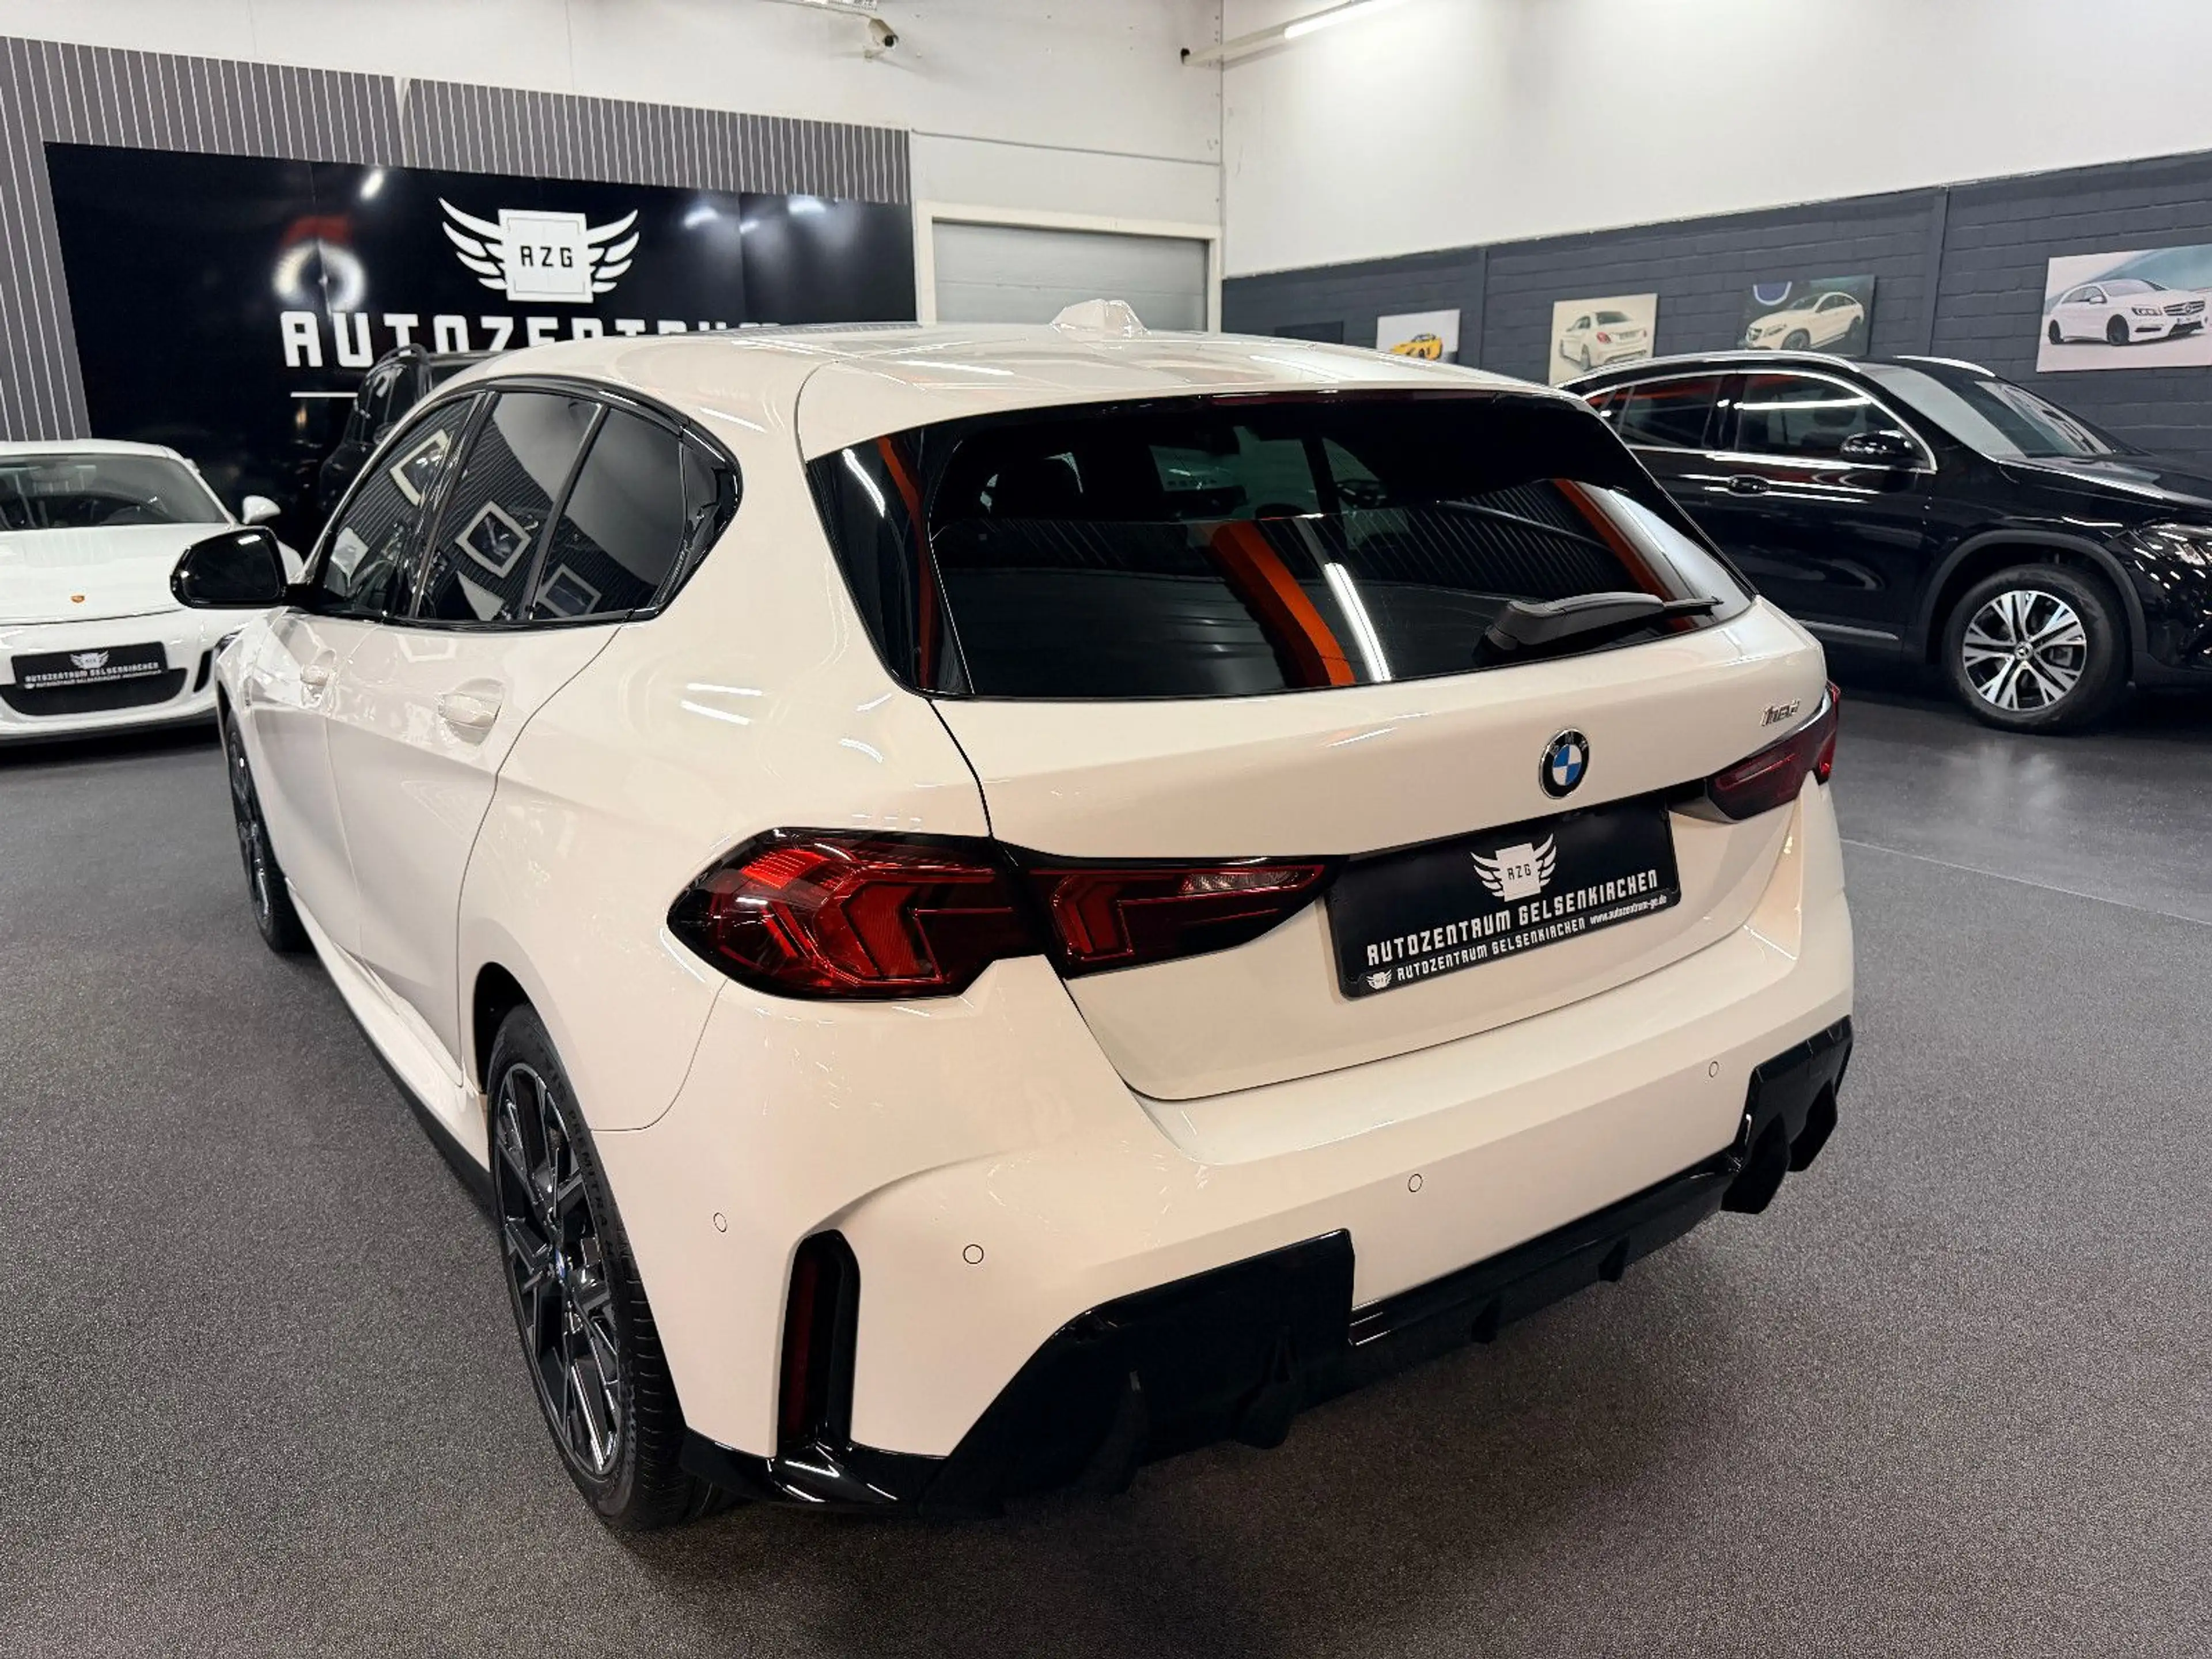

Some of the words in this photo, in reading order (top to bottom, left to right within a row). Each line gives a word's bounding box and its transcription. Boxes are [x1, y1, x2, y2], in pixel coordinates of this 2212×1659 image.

[520, 245, 573, 267] AZG
[1507, 863, 1532, 880] AZG
[1366, 910, 1511, 966] AUTOZENTRUM
[1518, 869, 1658, 926] GELSENKIRCHEN
[1397, 944, 1488, 981] AUTOZENTRUM
[1491, 917, 1585, 955] GELSENKIRCHEN
